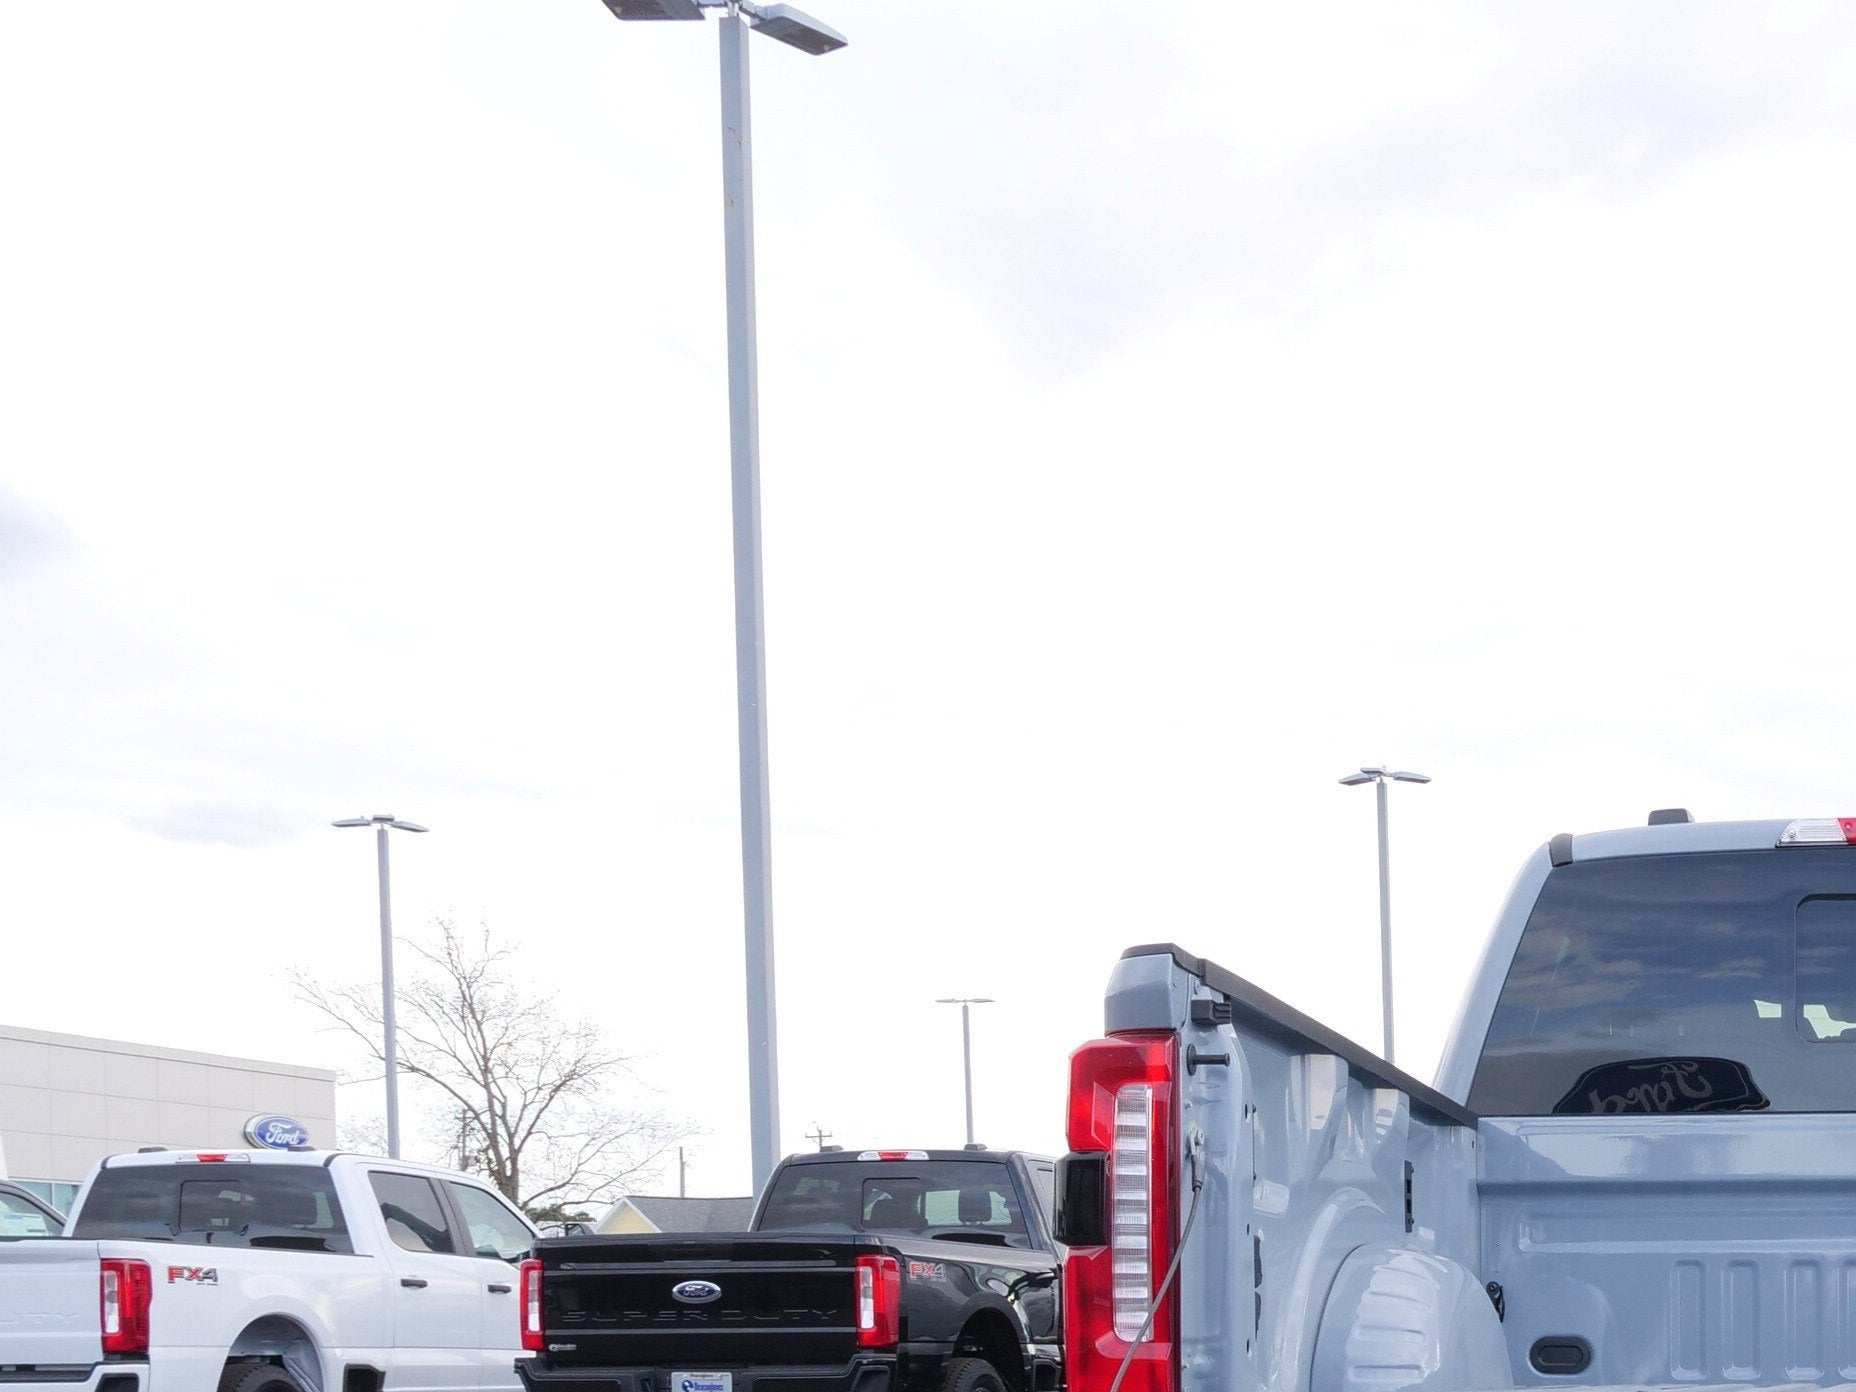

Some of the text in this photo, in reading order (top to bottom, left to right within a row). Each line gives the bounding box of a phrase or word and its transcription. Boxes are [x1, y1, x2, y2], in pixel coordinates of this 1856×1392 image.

[265, 1122, 301, 1145] Ford
[167, 1265, 218, 1284] FX4
[909, 1261, 945, 1279] FX4
[562, 1309, 838, 1322] SUPER DUTY
